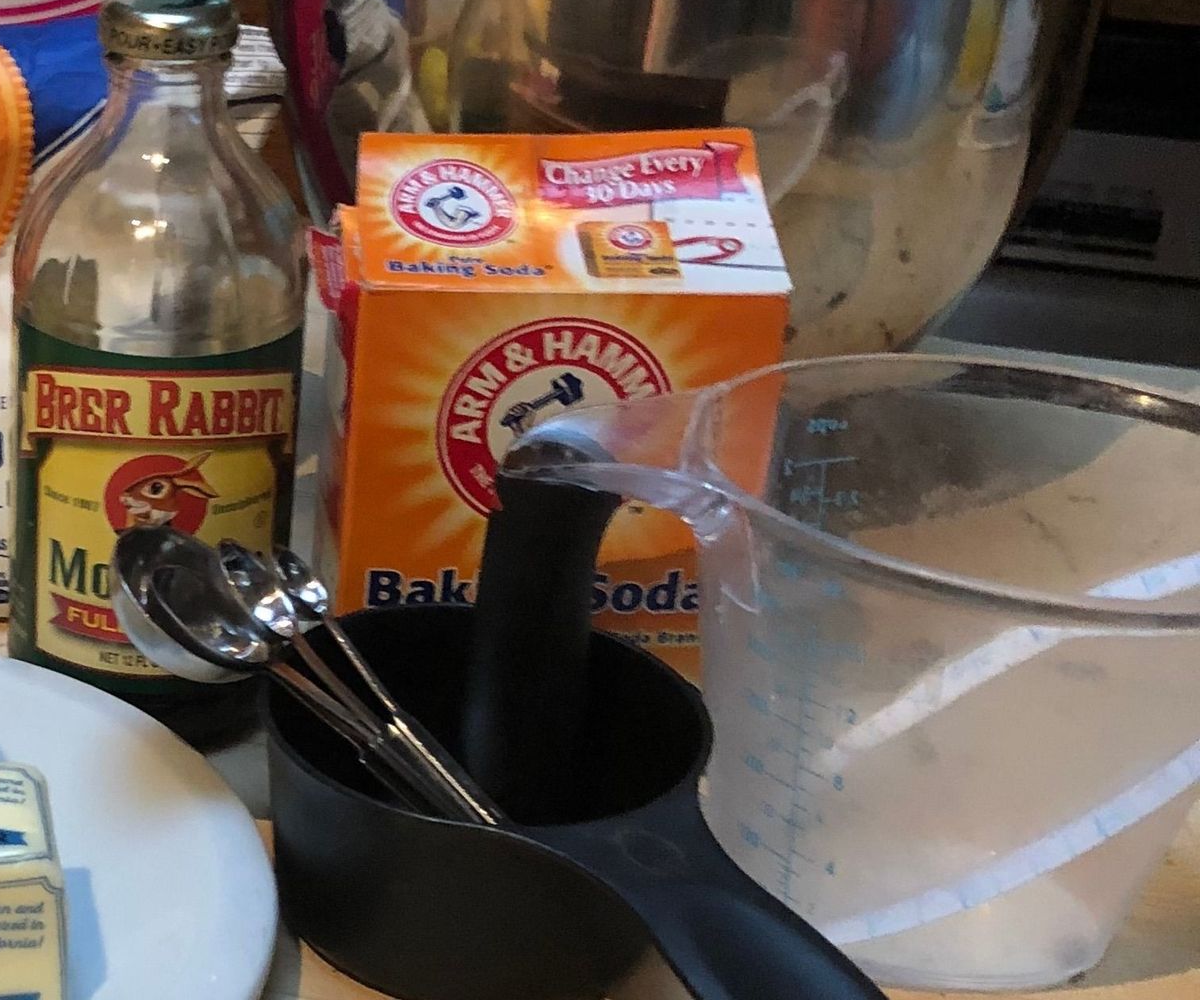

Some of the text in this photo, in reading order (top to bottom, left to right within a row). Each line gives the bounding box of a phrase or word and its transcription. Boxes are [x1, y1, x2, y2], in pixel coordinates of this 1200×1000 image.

[545, 155, 705, 186] Change Every
[619, 179, 677, 200] Days
[388, 260, 546, 278] Baking Soda
[451, 362, 508, 445] ARM
[502, 341, 539, 373] &
[15, 901, 45, 915] and
